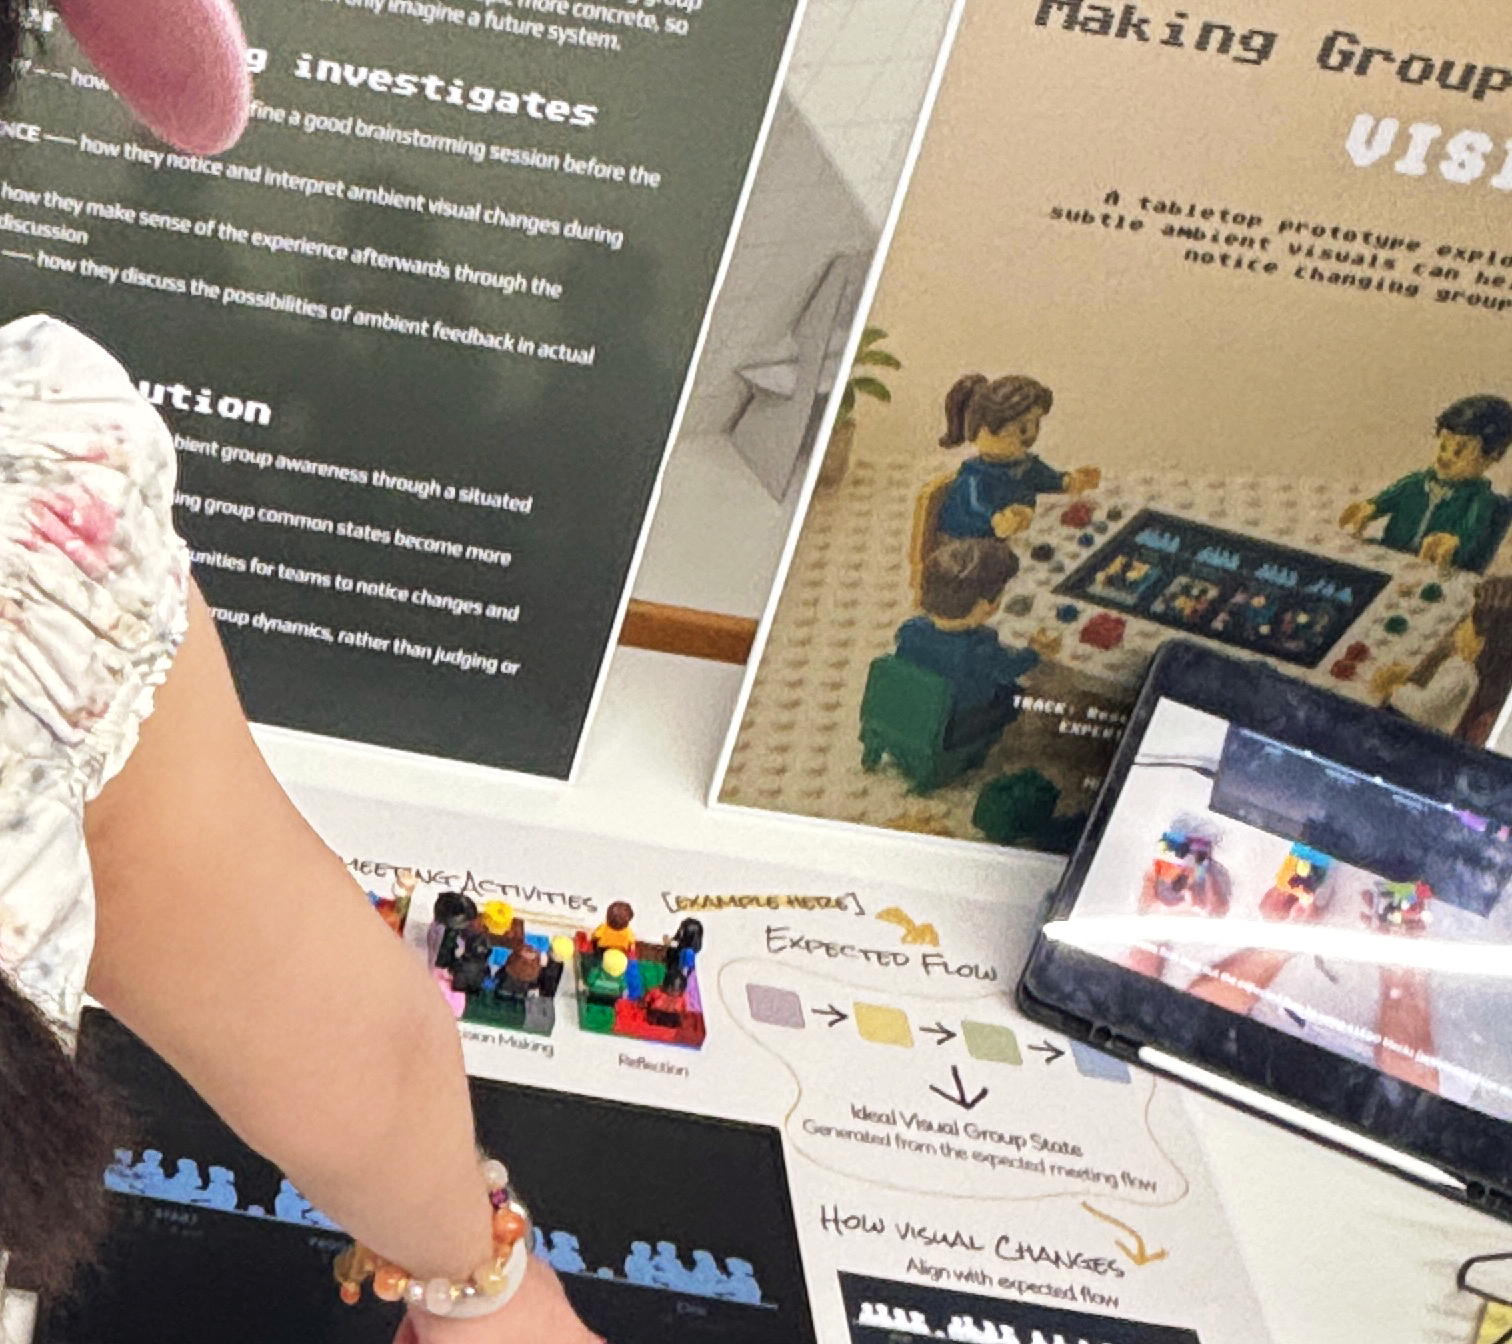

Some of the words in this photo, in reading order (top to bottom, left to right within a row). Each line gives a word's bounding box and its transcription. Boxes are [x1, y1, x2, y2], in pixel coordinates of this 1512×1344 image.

[295, 53, 598, 126] investigates
[1317, 31, 1512, 100] Group
[1049, 205, 1144, 231] subtle
[1161, 223, 1271, 251] ambient
[1288, 241, 1396, 270] visuals
[1413, 261, 1459, 280] can
[1140, 196, 1262, 228] tabletop
[1278, 219, 1420, 252] prototype
[1185, 250, 1278, 275] notice
[1294, 267, 1420, 297] changing
[37, 250, 76, 272] how
[80, 259, 119, 284] they
[121, 267, 187, 292] discuss
[191, 279, 221, 299] the
[223, 288, 327, 319] possibilities
[331, 305, 353, 321] of
[353, 311, 429, 337] ambient
[433, 321, 515, 352] feedback
[517, 337, 535, 355] in
[537, 343, 595, 365] actual
[250, 557, 275, 575] for
[279, 563, 331, 587] teams
[335, 575, 353, 591] to
[356, 581, 409, 601] notice
[411, 589, 482, 615] changes
[485, 605, 519, 621] and
[907, 1258, 951, 1282] Align
[954, 1266, 993, 1286] with
[998, 1274, 1076, 1302] expected
[1080, 1285, 1119, 1309] flow
